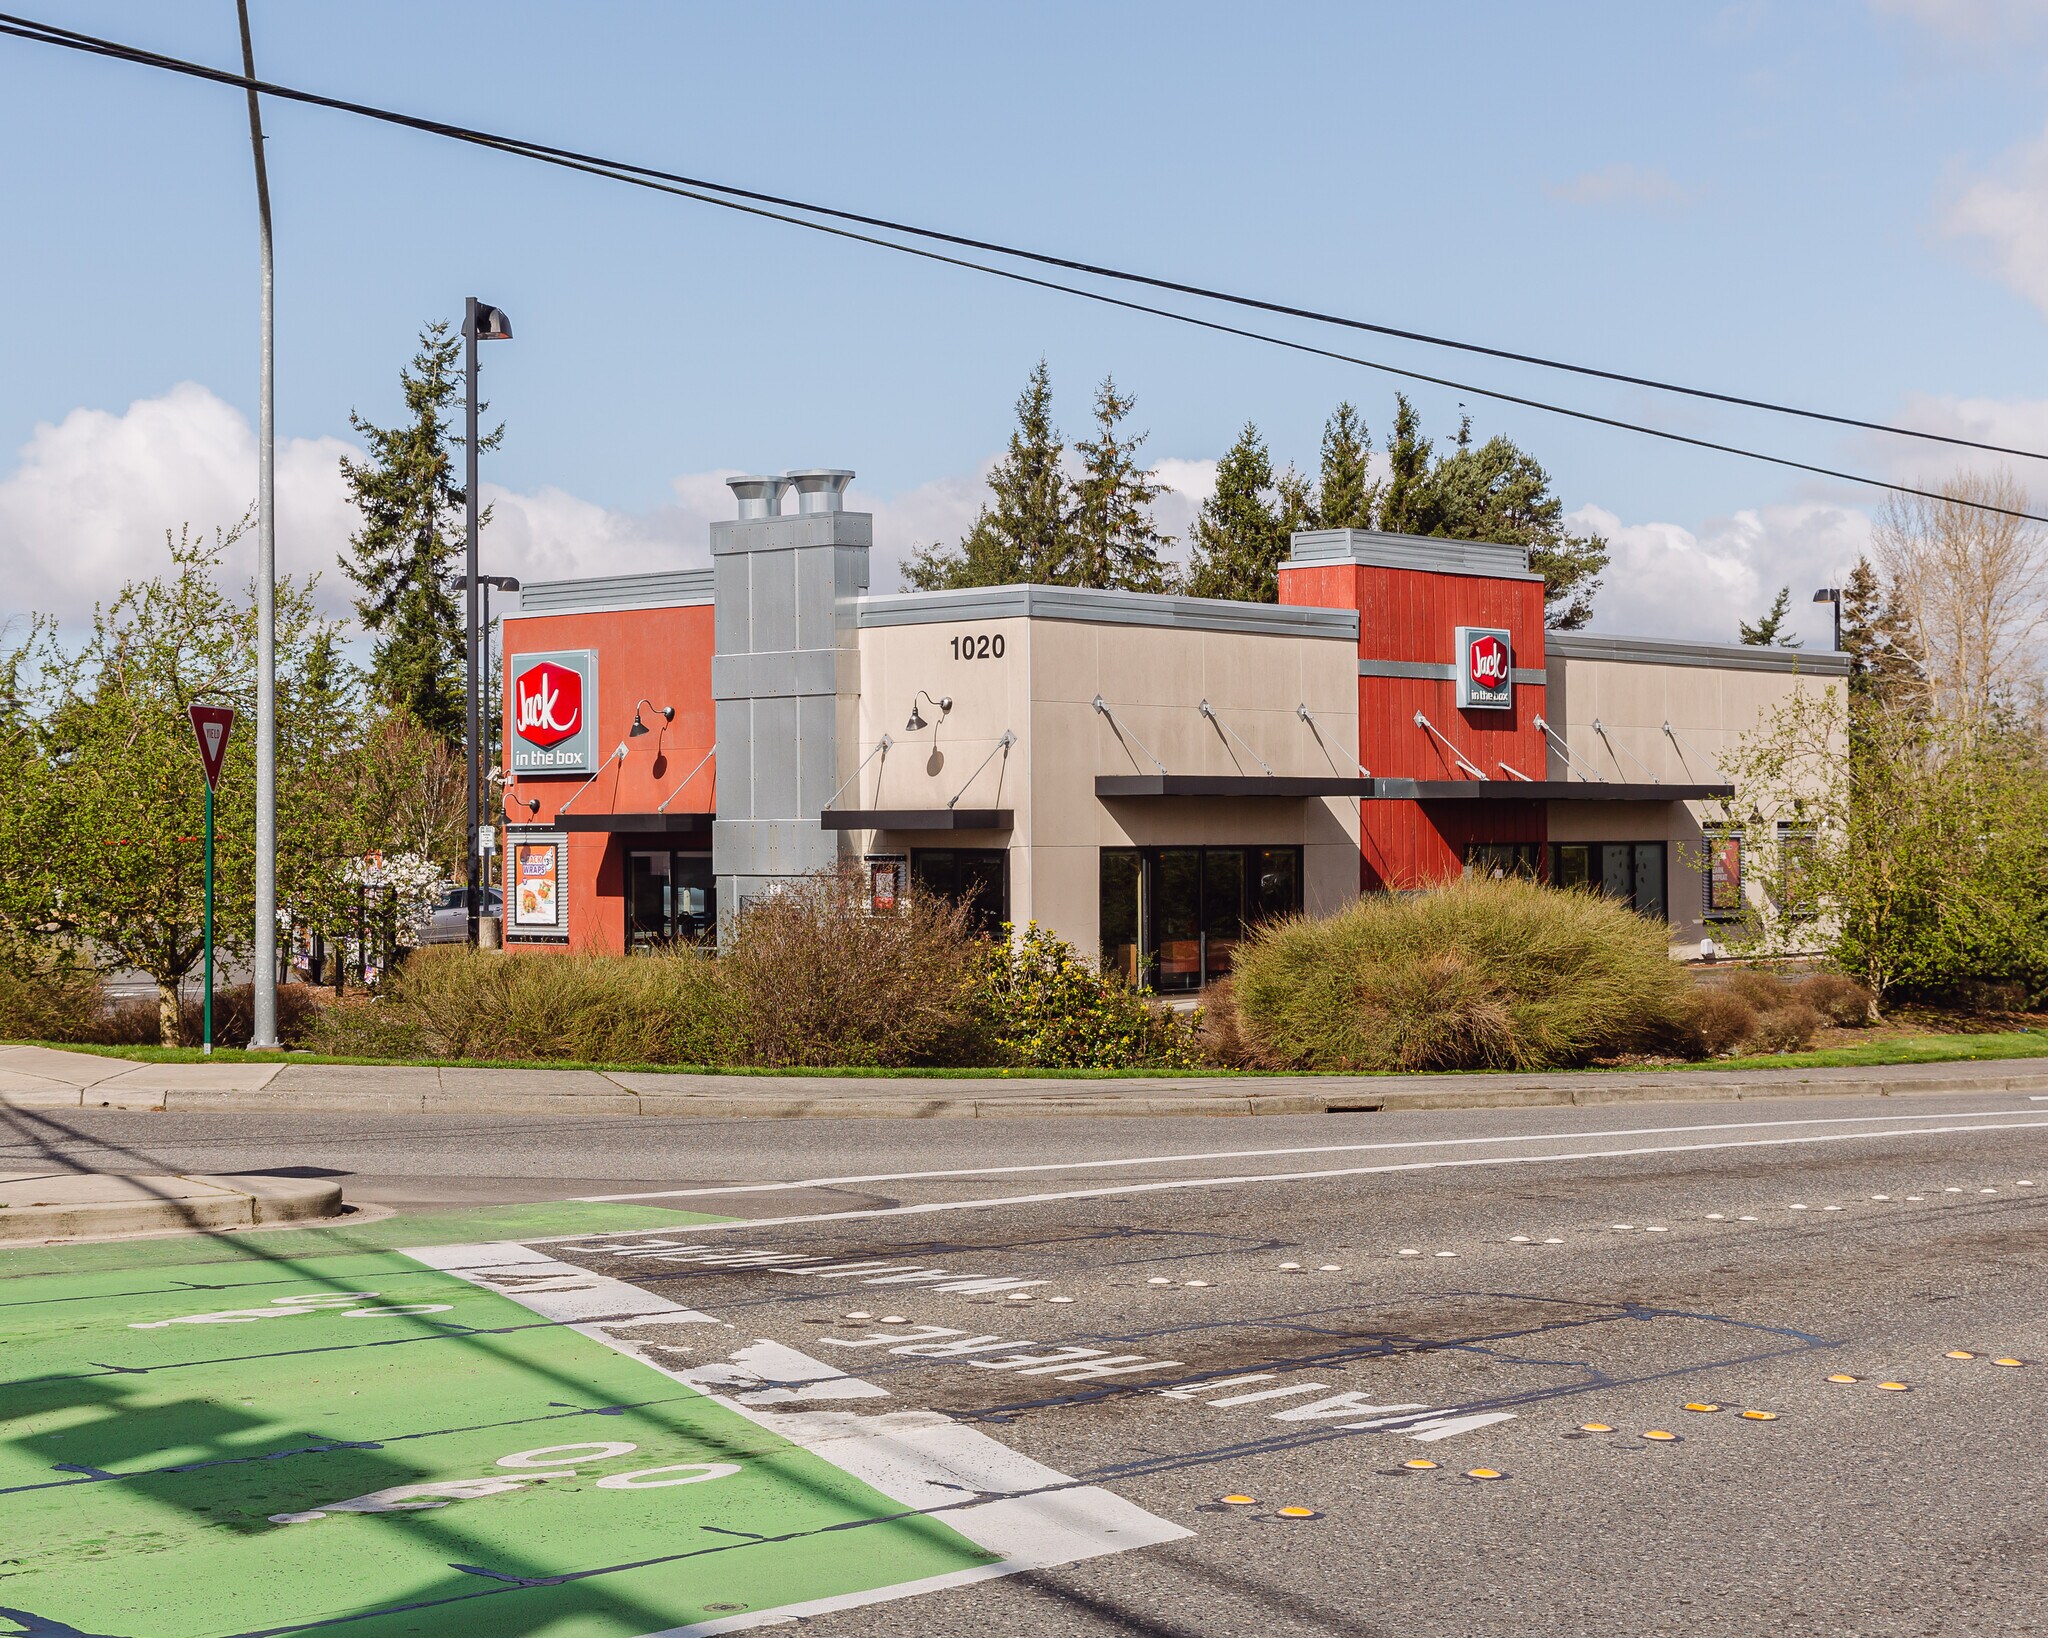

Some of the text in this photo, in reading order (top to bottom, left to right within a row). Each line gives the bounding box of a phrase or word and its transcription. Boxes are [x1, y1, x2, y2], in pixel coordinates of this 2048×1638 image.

[950, 634, 1005, 660] 1020
[1473, 642, 1507, 679] Jack
[517, 672, 578, 732] Jack
[1471, 690, 1508, 701] in the box
[206, 728, 221, 739] YIELD
[516, 750, 582, 765] in the box
[523, 866, 545, 874] WRAPS
